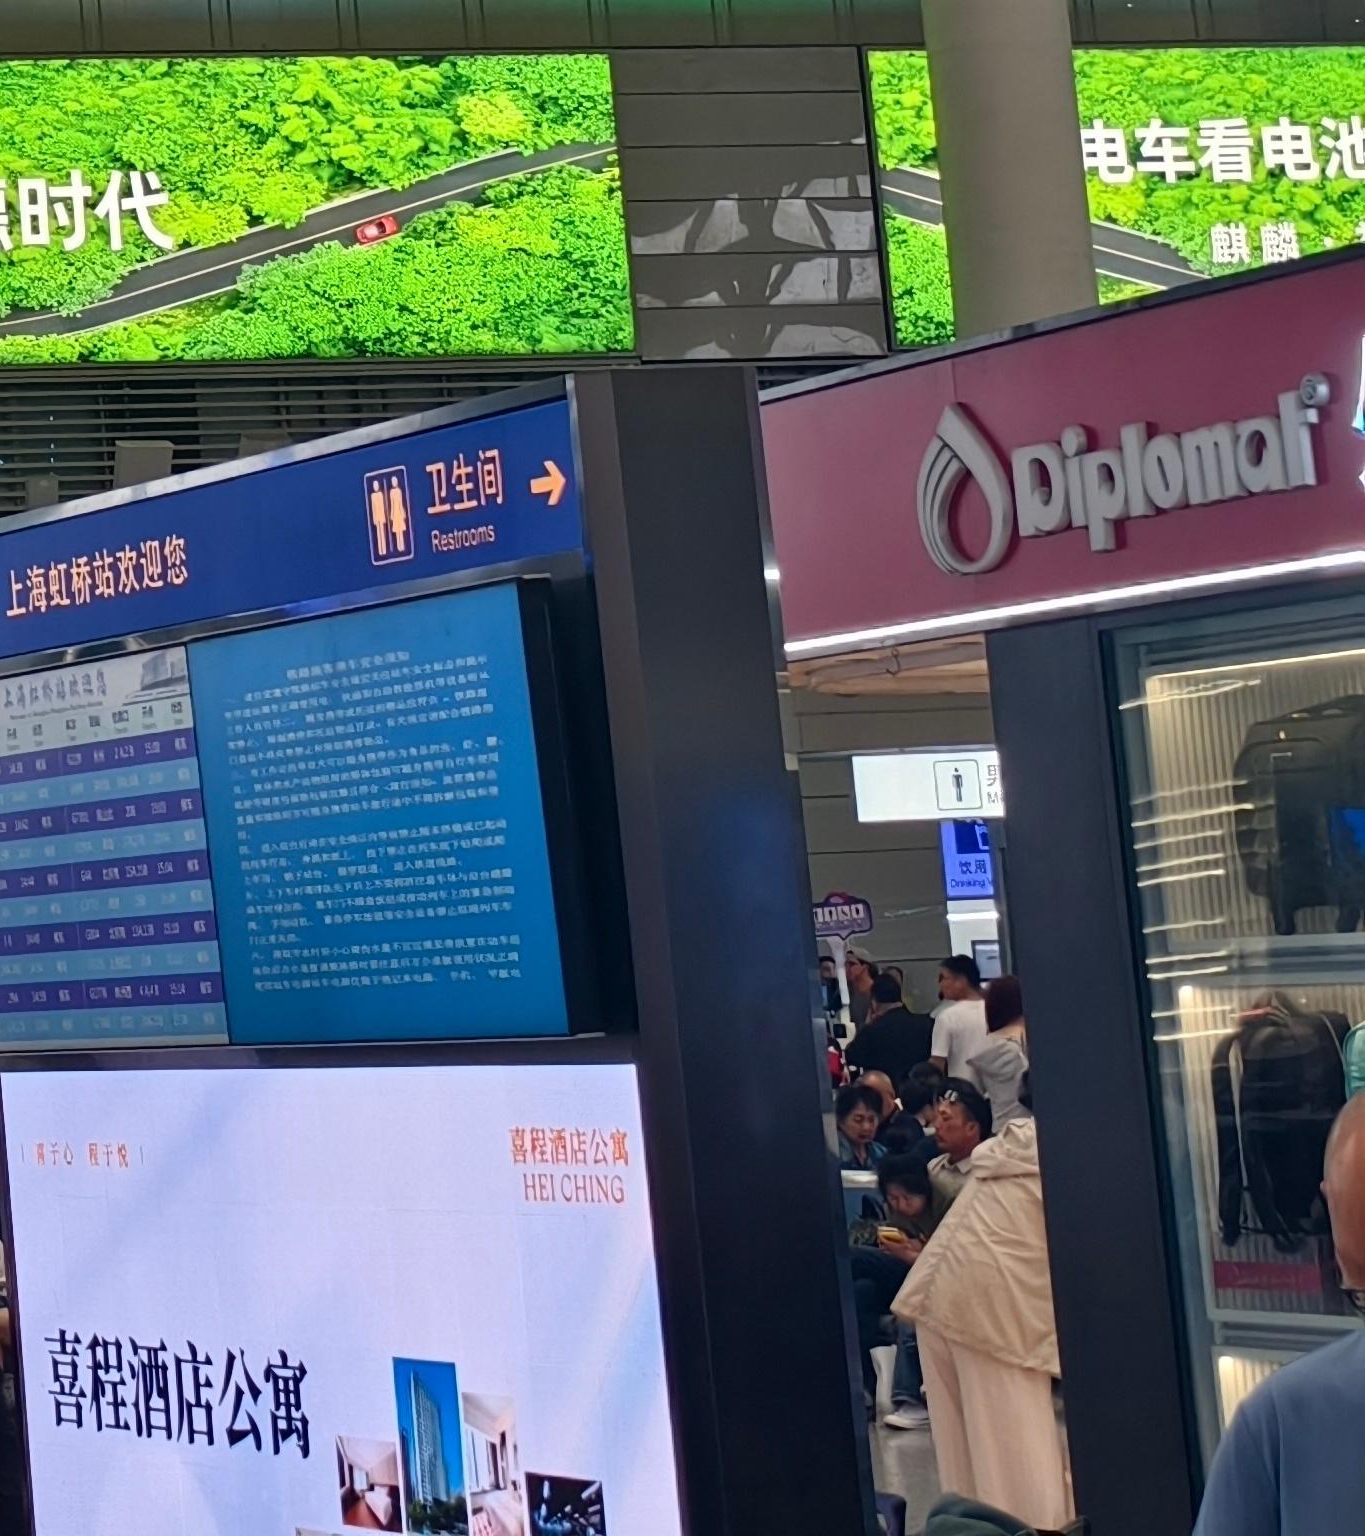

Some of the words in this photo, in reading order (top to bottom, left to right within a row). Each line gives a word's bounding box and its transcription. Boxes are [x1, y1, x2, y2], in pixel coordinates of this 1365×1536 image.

[1081, 116, 1365, 183] 电车看电池
[426, 448, 505, 515] 卫生间
[1012, 389, 1320, 552] Diplomat
[431, 522, 496, 555] Restrooms
[6, 533, 189, 618] 上海虹桥站欢迎您
[509, 1126, 629, 1166] 喜程酒店公寓
[523, 1173, 556, 1202] HEI
[560, 1174, 625, 1204] CHING
[44, 1327, 310, 1460] 喜程酒店公寓
